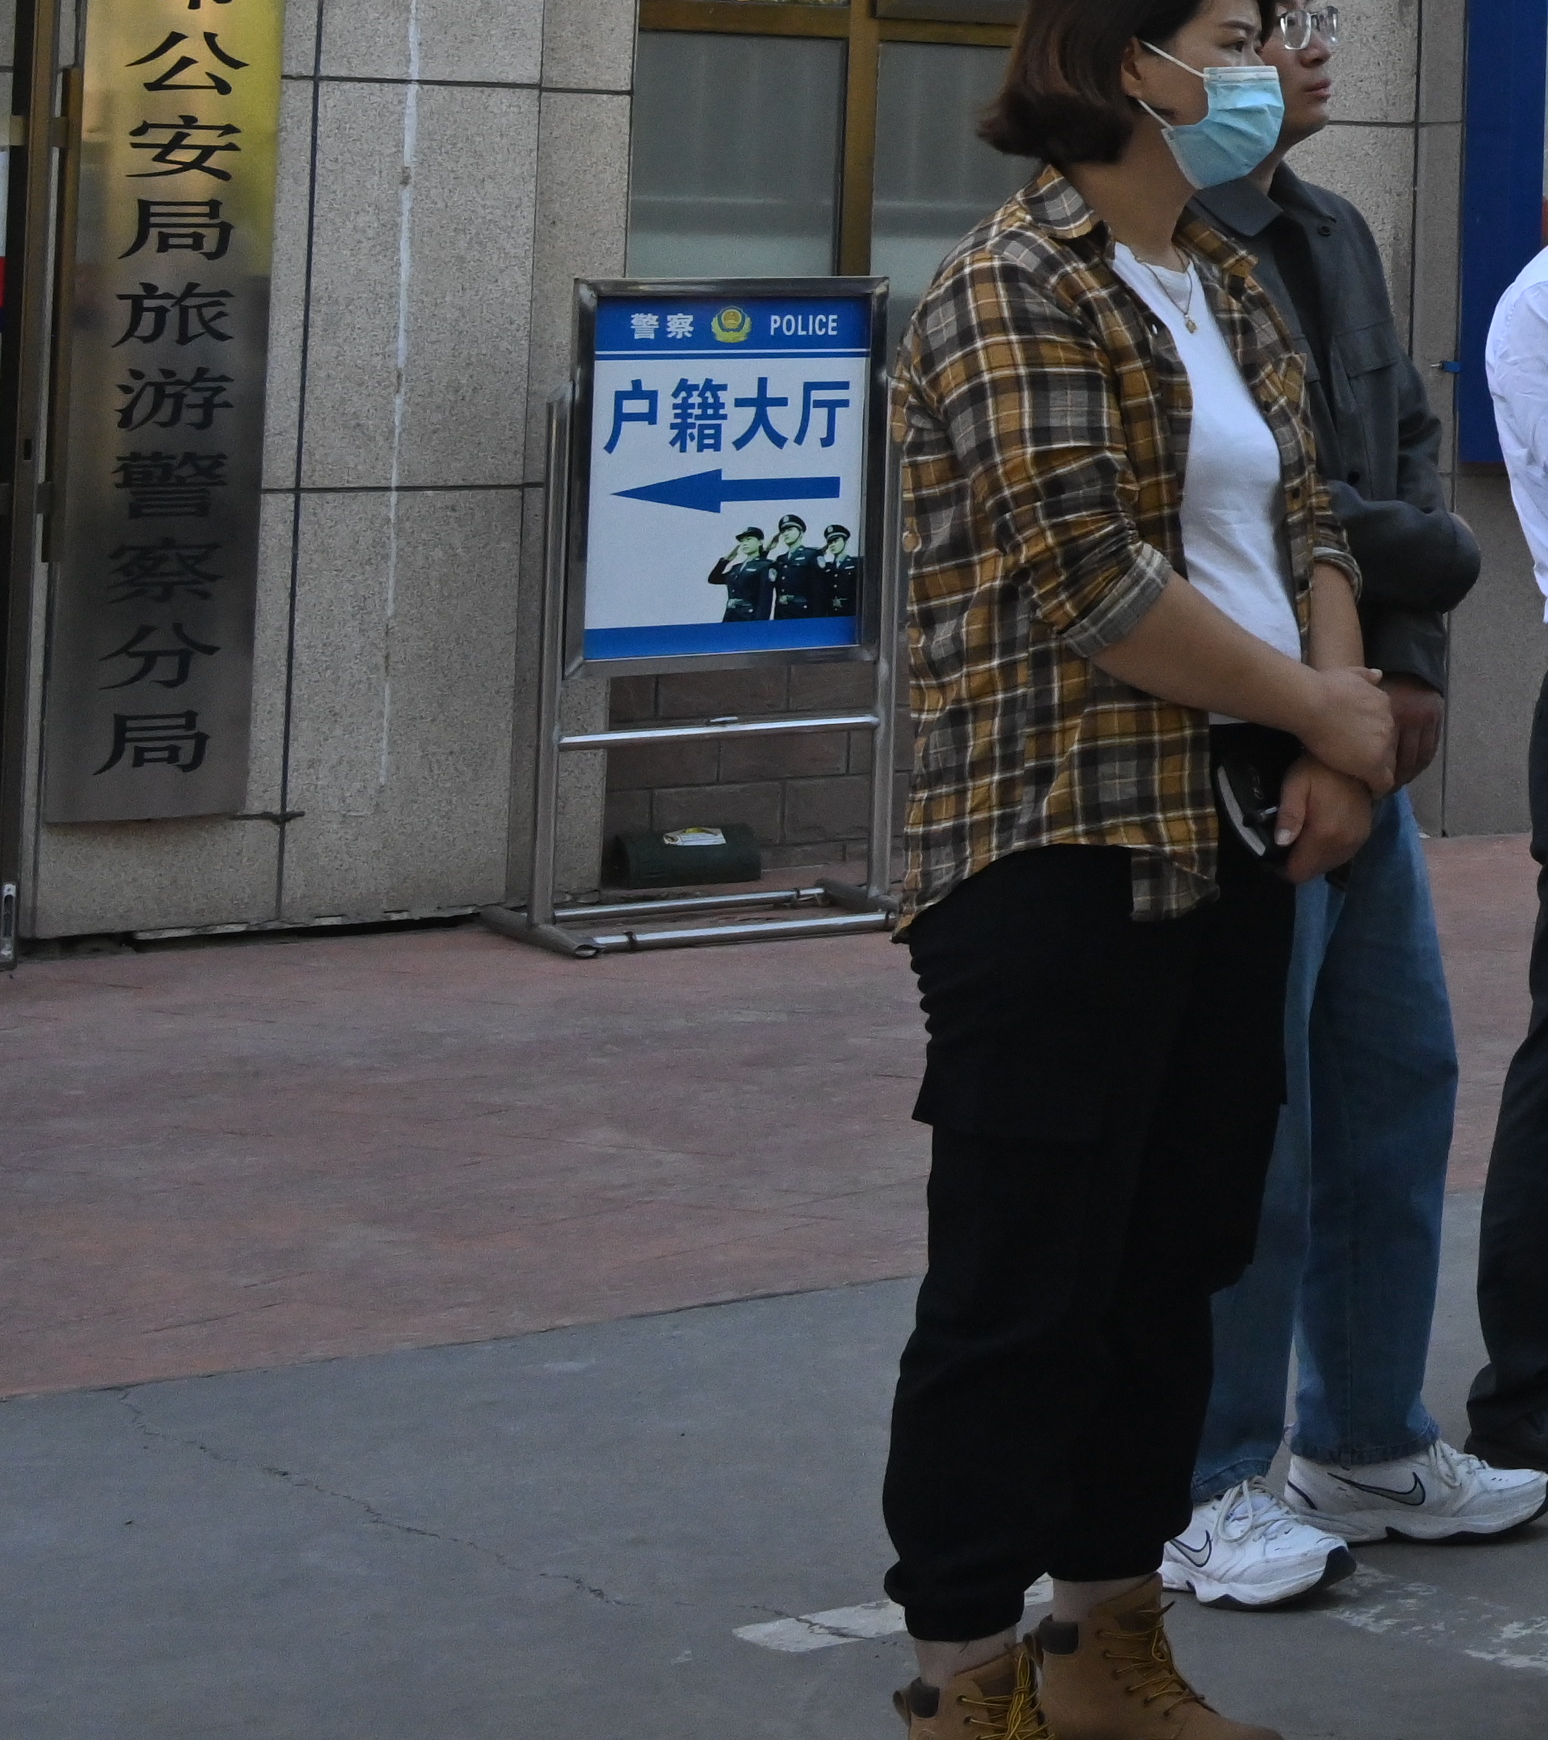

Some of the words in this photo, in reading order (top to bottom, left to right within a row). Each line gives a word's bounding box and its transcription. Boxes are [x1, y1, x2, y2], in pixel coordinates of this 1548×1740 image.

[630, 312, 695, 341] 警察
[769, 313, 838, 337] POLICE
[602, 377, 851, 454] 户籍大厅
